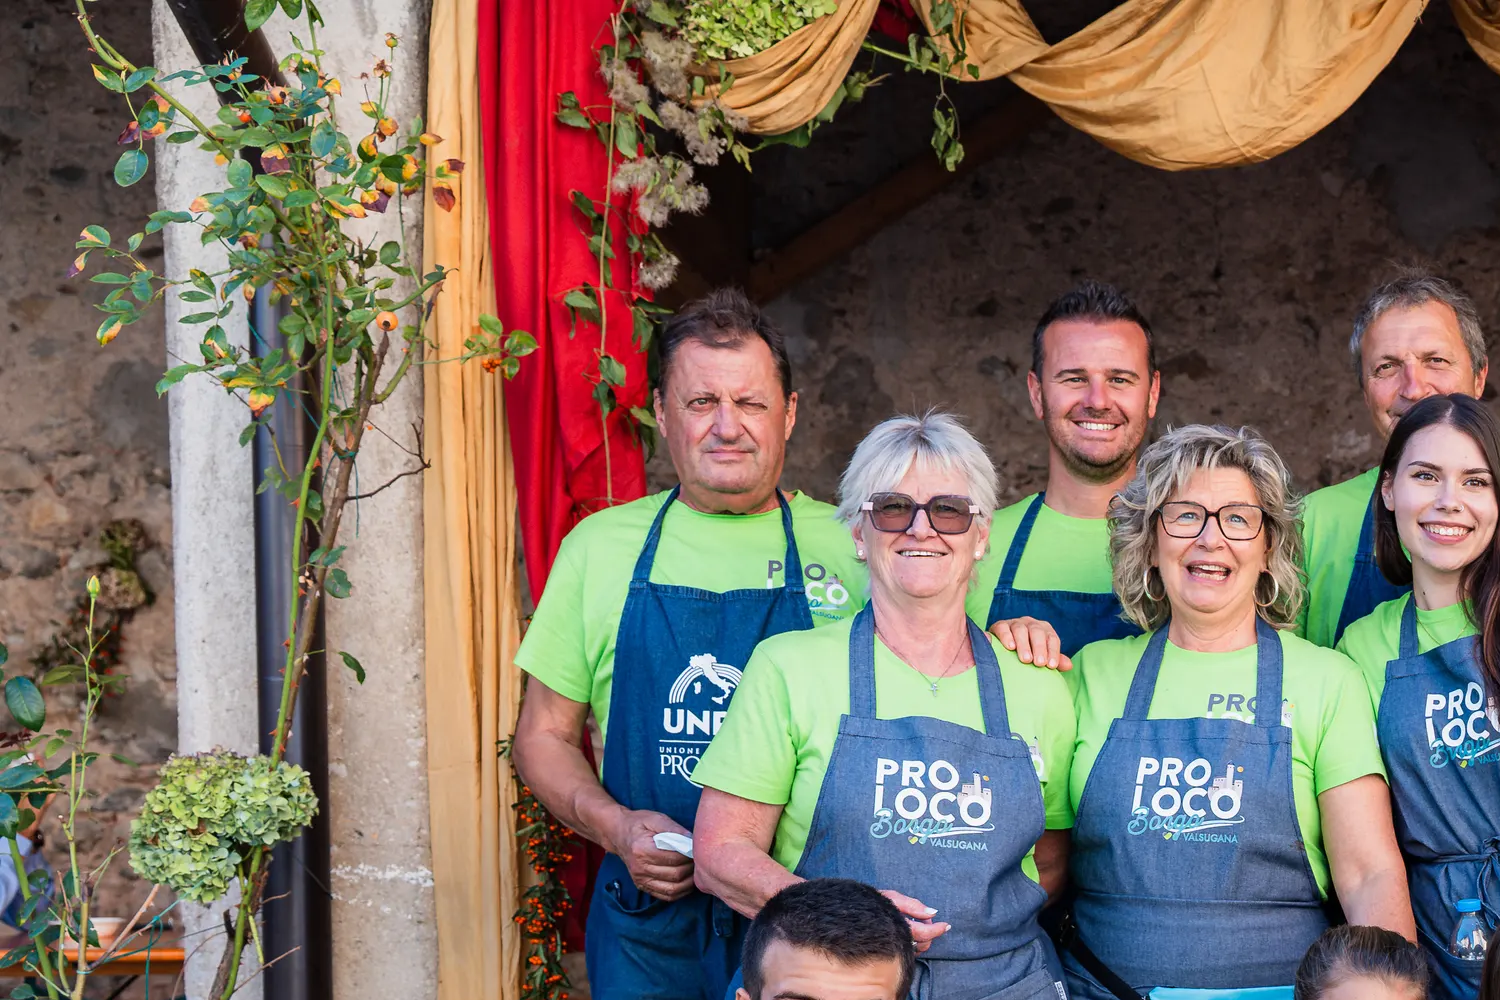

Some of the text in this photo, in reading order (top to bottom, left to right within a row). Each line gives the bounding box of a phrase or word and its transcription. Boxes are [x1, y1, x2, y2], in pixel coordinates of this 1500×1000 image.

[767, 560, 826, 581] PO
[1424, 682, 1484, 720] PRO
[659, 746, 700, 755] UNIONE
[875, 757, 960, 791] PRO
[1135, 756, 1212, 787] PRO
[873, 787, 993, 827] LOCO
[1131, 785, 1241, 820] LOCO
[869, 807, 954, 845] Borgo
[1127, 806, 1205, 841] Borgo
[1183, 832, 1239, 844] VALSUGANA
[929, 837, 989, 852] VALSUGANA
